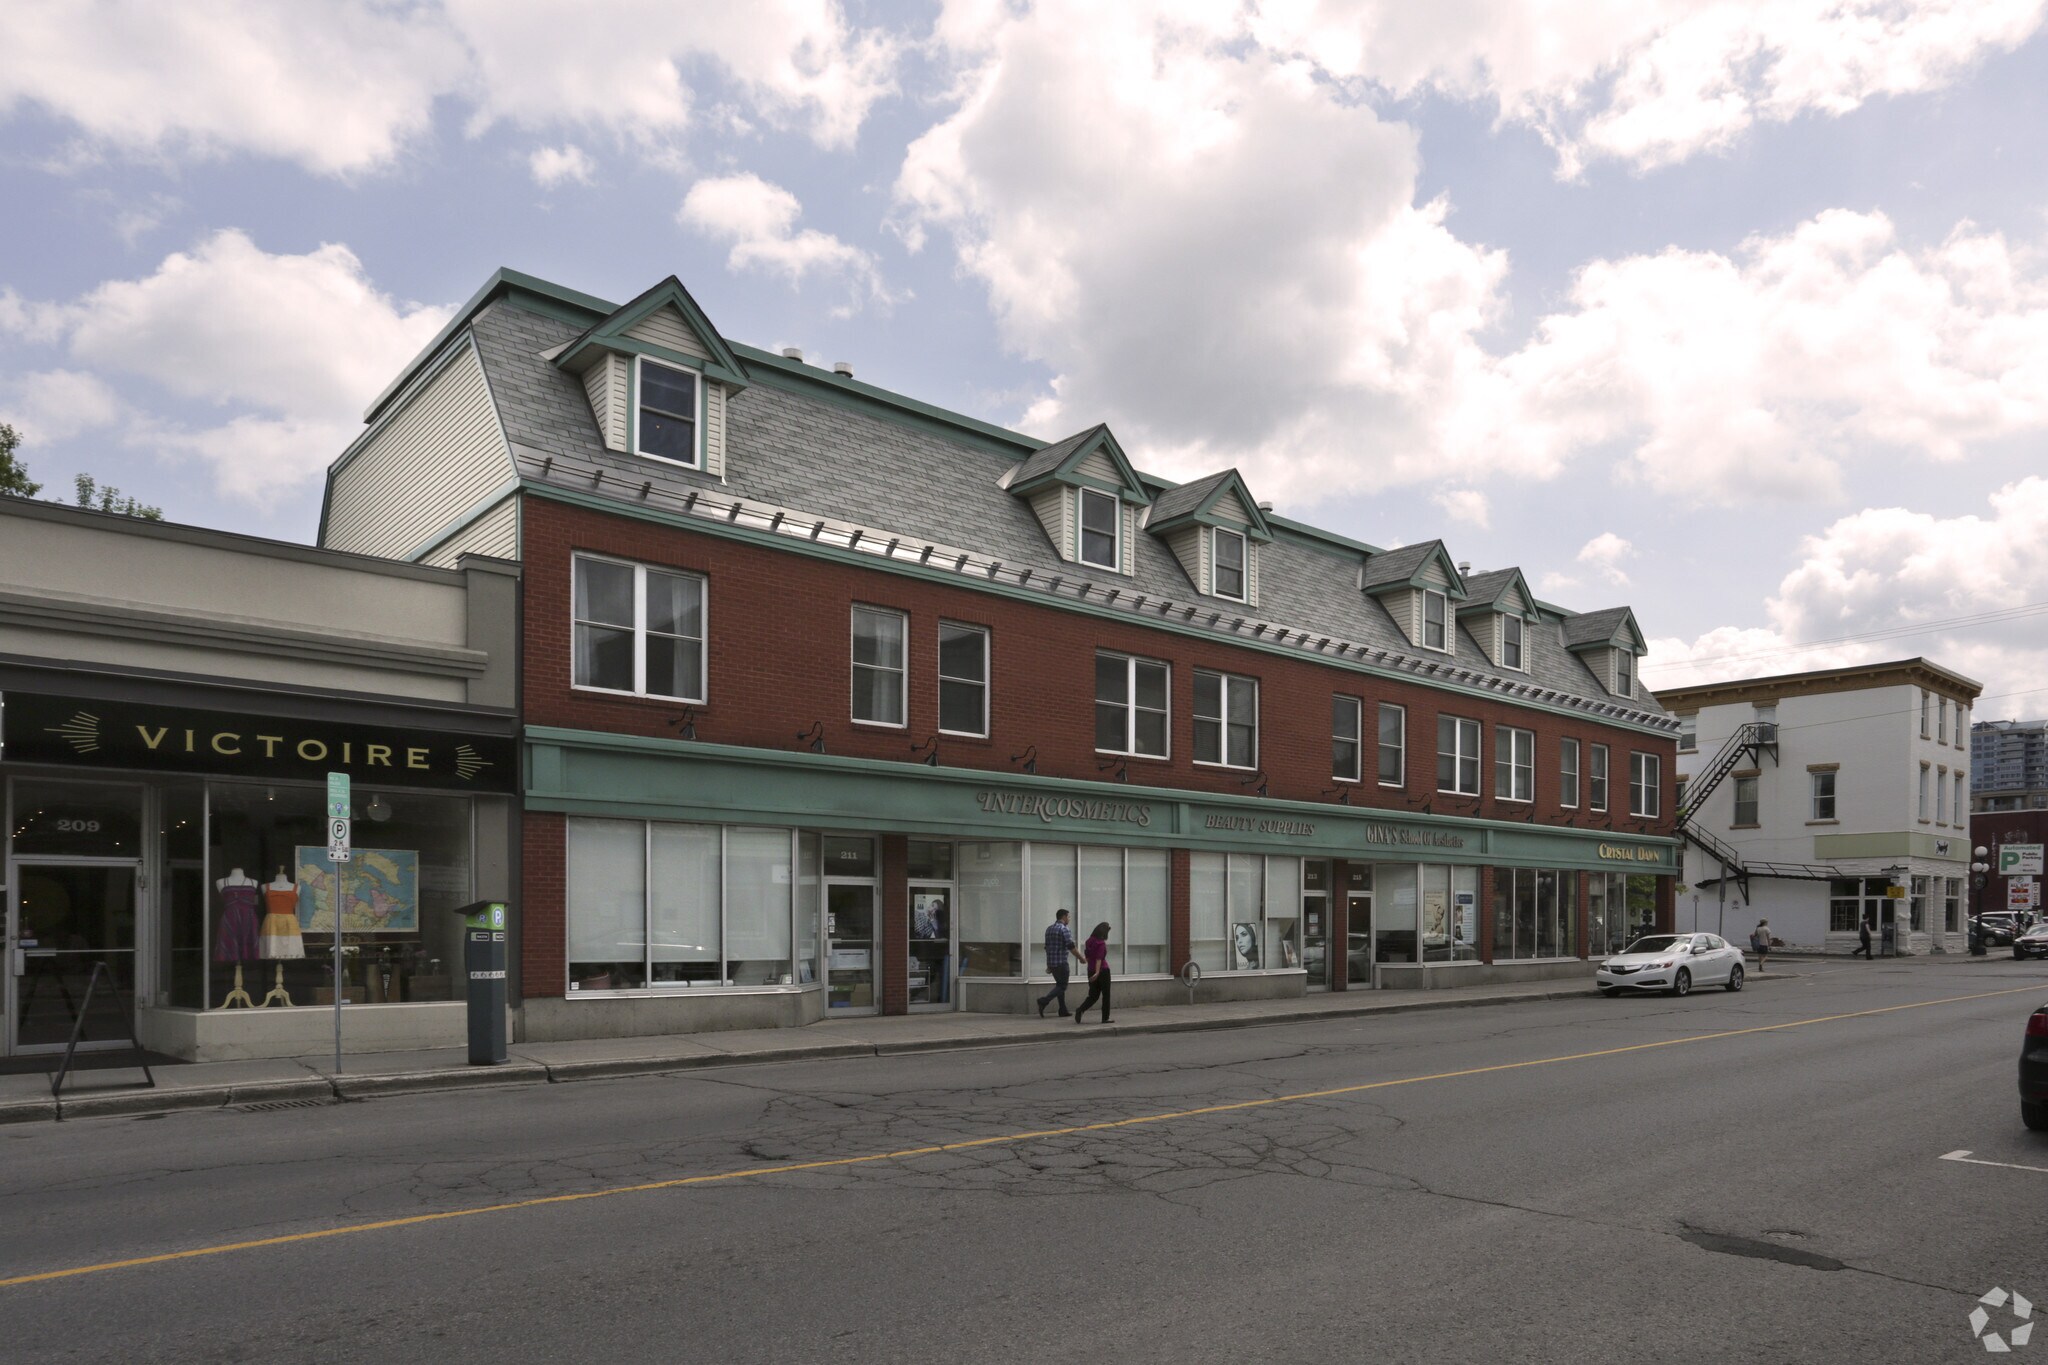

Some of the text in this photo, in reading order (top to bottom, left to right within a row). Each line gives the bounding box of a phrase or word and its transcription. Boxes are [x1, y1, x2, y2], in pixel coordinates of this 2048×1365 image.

[136, 725, 430, 769] VICTOIRE
[977, 791, 1151, 827] INTERCOSMETICS
[57, 819, 100, 832] 209
[336, 824, 343, 834] P
[1205, 814, 1315, 836] BEAUTY SUPPLIES
[1367, 823, 1398, 845] GINA'S
[1400, 829, 1421, 845] School
[840, 851, 858, 860] 211
[1599, 842, 1660, 861] CRYSTAL DAWN
[2001, 852, 2020, 871] P
